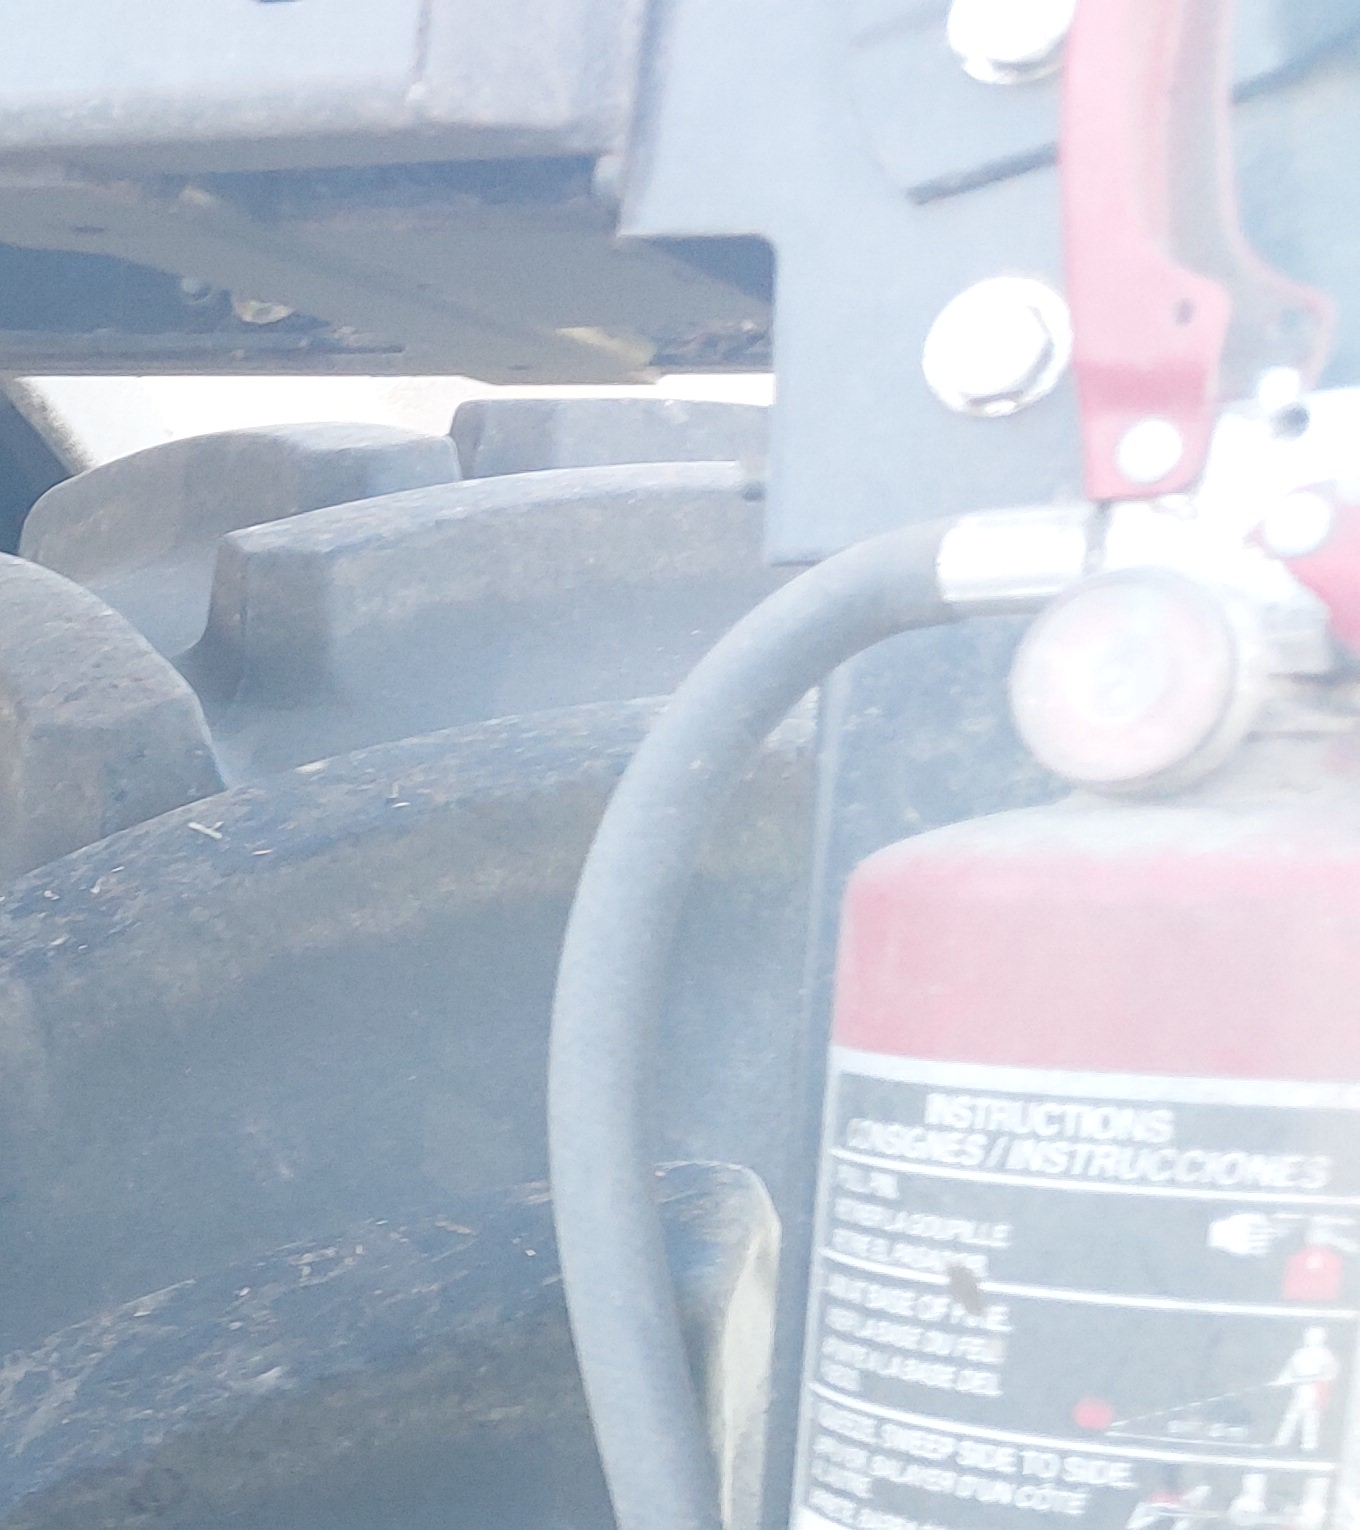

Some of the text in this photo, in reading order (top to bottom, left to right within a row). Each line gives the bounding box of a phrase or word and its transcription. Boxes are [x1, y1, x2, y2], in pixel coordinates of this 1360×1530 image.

[925, 1092, 1176, 1143] INSTRUCTIONS
[1007, 1138, 1333, 1190] INSTRUCCIONES
[1018, 1450, 1060, 1479] TO
